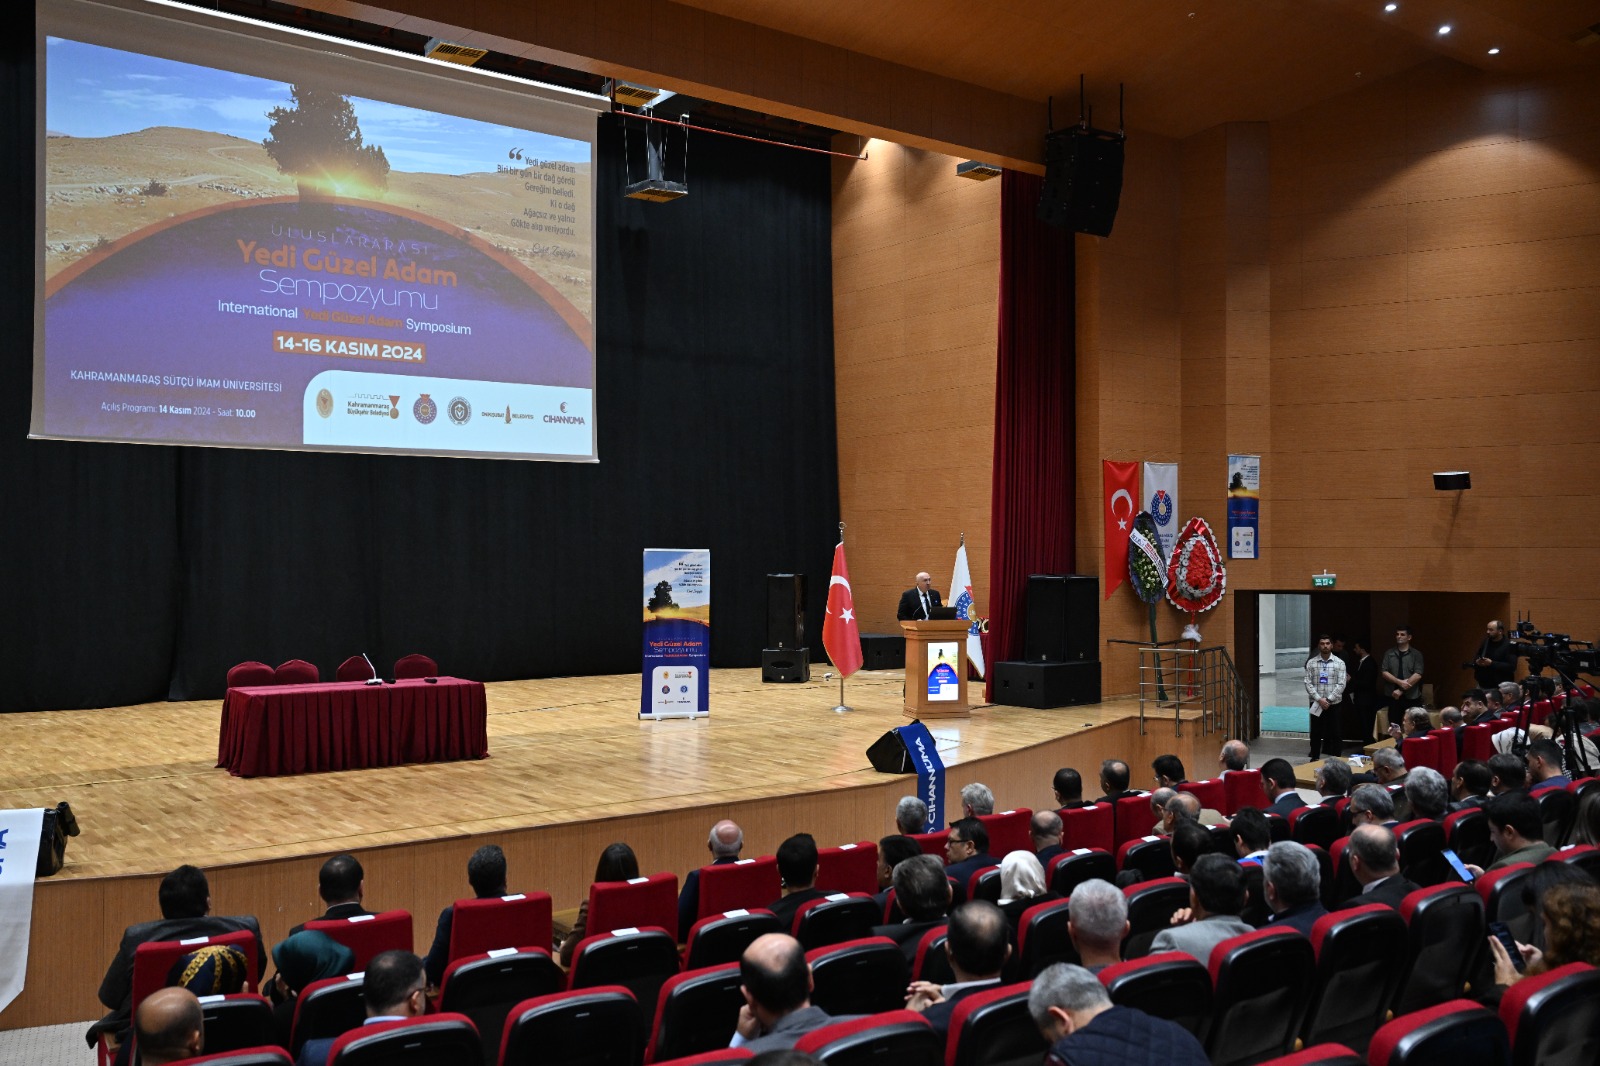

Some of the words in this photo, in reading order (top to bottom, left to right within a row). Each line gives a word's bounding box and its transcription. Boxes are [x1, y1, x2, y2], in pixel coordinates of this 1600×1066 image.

[525, 156, 539, 167] Yedi
[540, 160, 557, 170] güzel
[558, 165, 576, 173] adam
[497, 164, 508, 174] Biri
[509, 166, 519, 175] bir
[520, 170, 532, 179] gün
[533, 171, 542, 180] bir
[543, 174, 556, 183] dağ
[557, 176, 576, 186] gördü
[525, 182, 551, 195] Gereğini
[523, 207, 547, 219] Ağaçsız
[557, 213, 576, 224] yalnız
[550, 199, 557, 208] Ki
[563, 202, 576, 213] dağ
[511, 218, 530, 230] Gökte
[544, 225, 576, 237] veriyordu.
[271, 223, 429, 255] ULUSLARARASI
[236, 239, 296, 268] Yedi
[302, 248, 377, 278] Güzel
[383, 258, 458, 288] Adam
[259, 268, 439, 310] Sempozyumu
[218, 299, 298, 319] International
[302, 307, 329, 322] Yedi
[331, 311, 365, 325] Güzel
[367, 314, 403, 329] Adam
[406, 318, 472, 335] Symposium
[276, 335, 322, 352] 14-16
[325, 340, 378, 358] KASIM
[381, 344, 423, 361] 2024
[70, 369, 161, 386] KAHRAMANMARAŞ
[163, 374, 194, 388] SÜTÇÜ
[196, 375, 221, 389] İMAM
[101, 401, 121, 412] Açılış
[159, 404, 168, 414] 14
[169, 405, 192, 415] Kasım
[193, 406, 211, 416] 2024
[235, 408, 256, 418] 10.00
[347, 401, 390, 410] Kahramanmaraş
